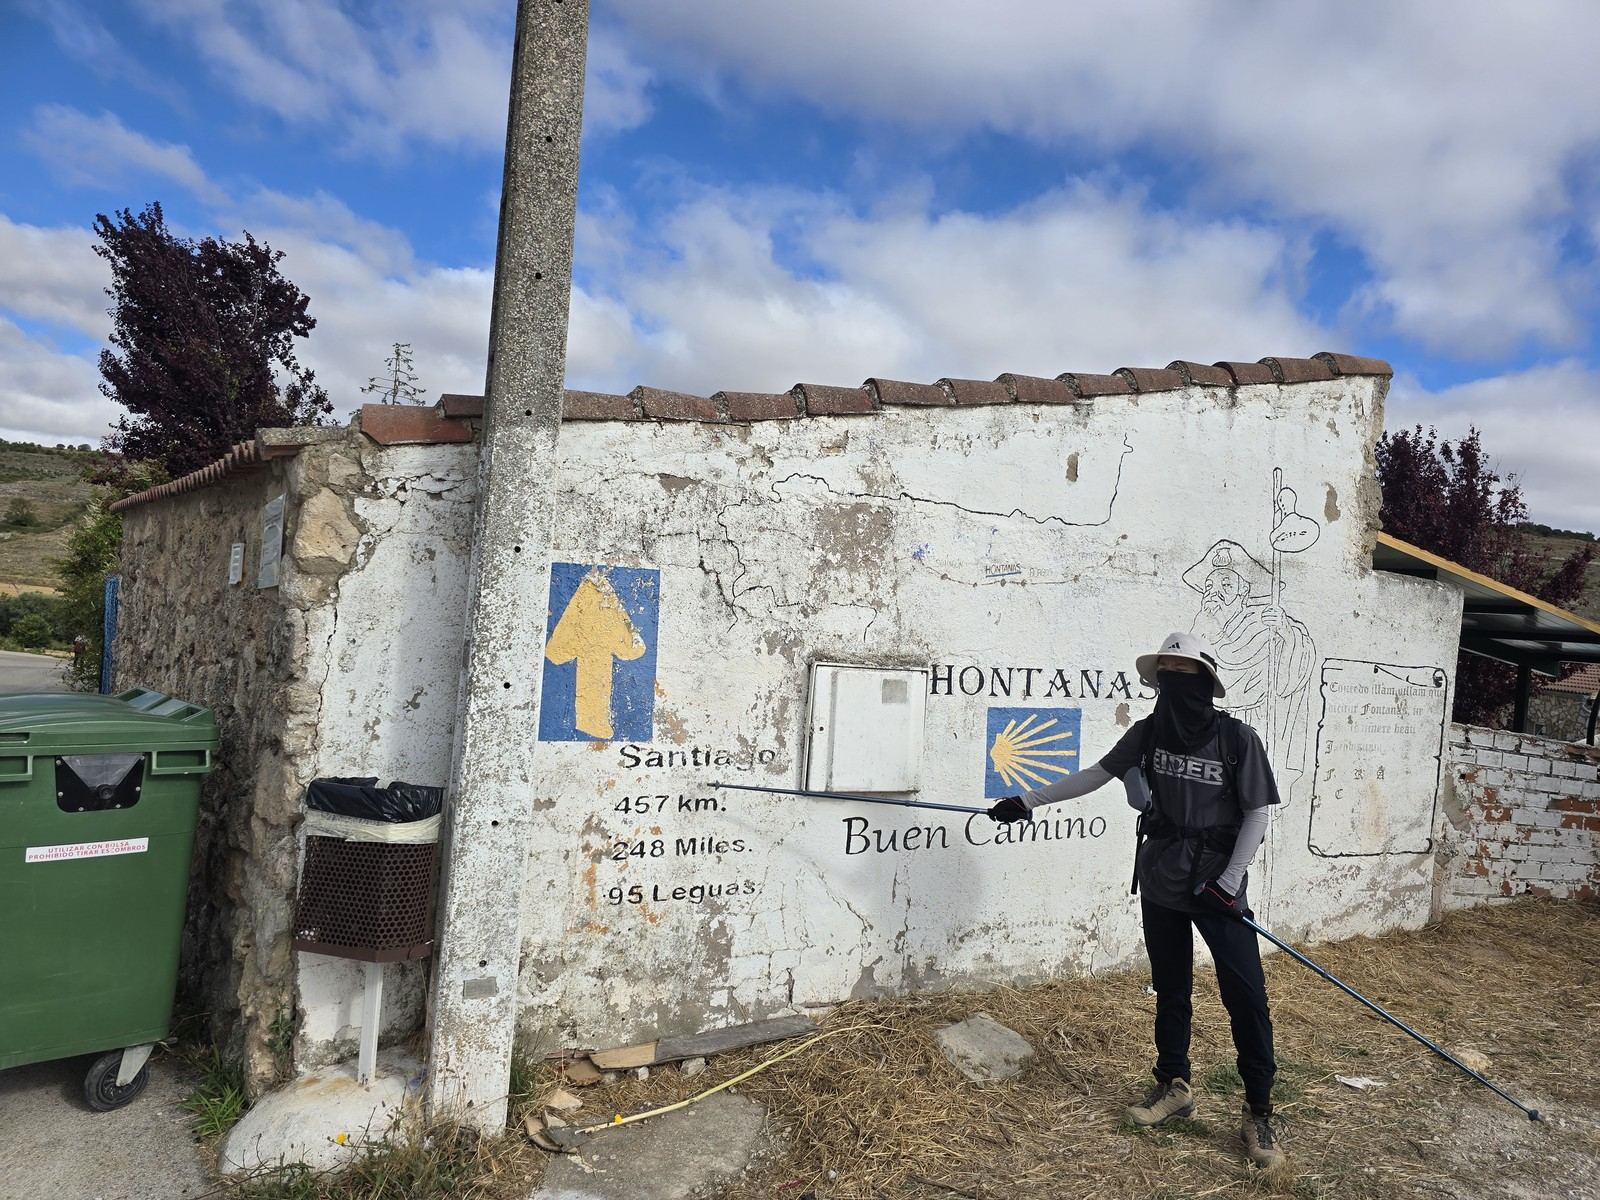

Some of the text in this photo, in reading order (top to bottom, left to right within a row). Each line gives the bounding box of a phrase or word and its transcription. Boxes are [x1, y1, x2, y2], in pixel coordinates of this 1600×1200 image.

[1153, 751, 1223, 781] EIDER
[614, 794, 727, 815] 457 km.
[842, 808, 1107, 855] Buen Camino
[29, 851, 74, 860] PROHIBIDO
[48, 841, 129, 854] UTILIZAR CON BOLSA
[612, 836, 752, 861] 248 Miles.
[608, 885, 643, 905] 95
